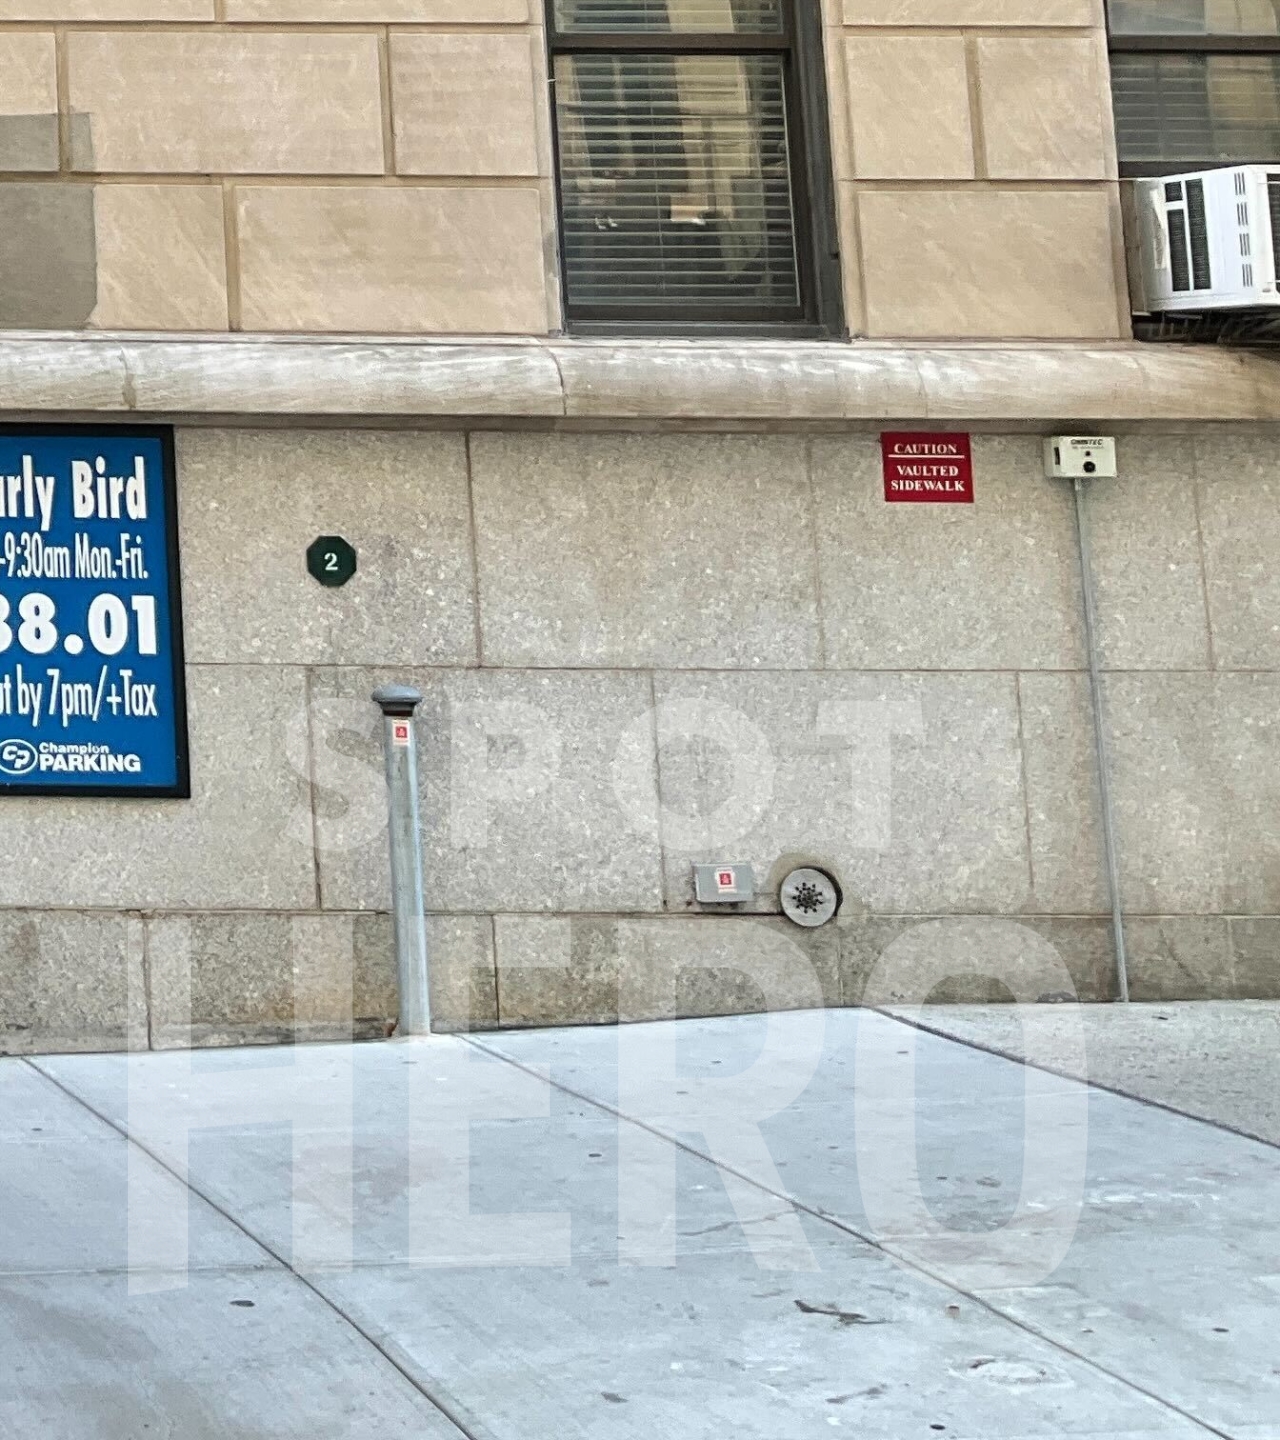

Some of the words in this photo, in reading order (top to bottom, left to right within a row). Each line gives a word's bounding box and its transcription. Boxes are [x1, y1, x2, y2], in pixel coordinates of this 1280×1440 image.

[894, 443, 957, 454] CAUTION
[897, 465, 959, 477] VAULTED
[71, 455, 147, 520] Bird
[891, 480, 965, 492] SIDEWALK
[74, 532, 149, 579] Mon.-Fri.
[324, 552, 339, 572] 2
[16, 663, 43, 727] by
[39, 741, 110, 755] Champion
[39, 753, 141, 772] PARKING
